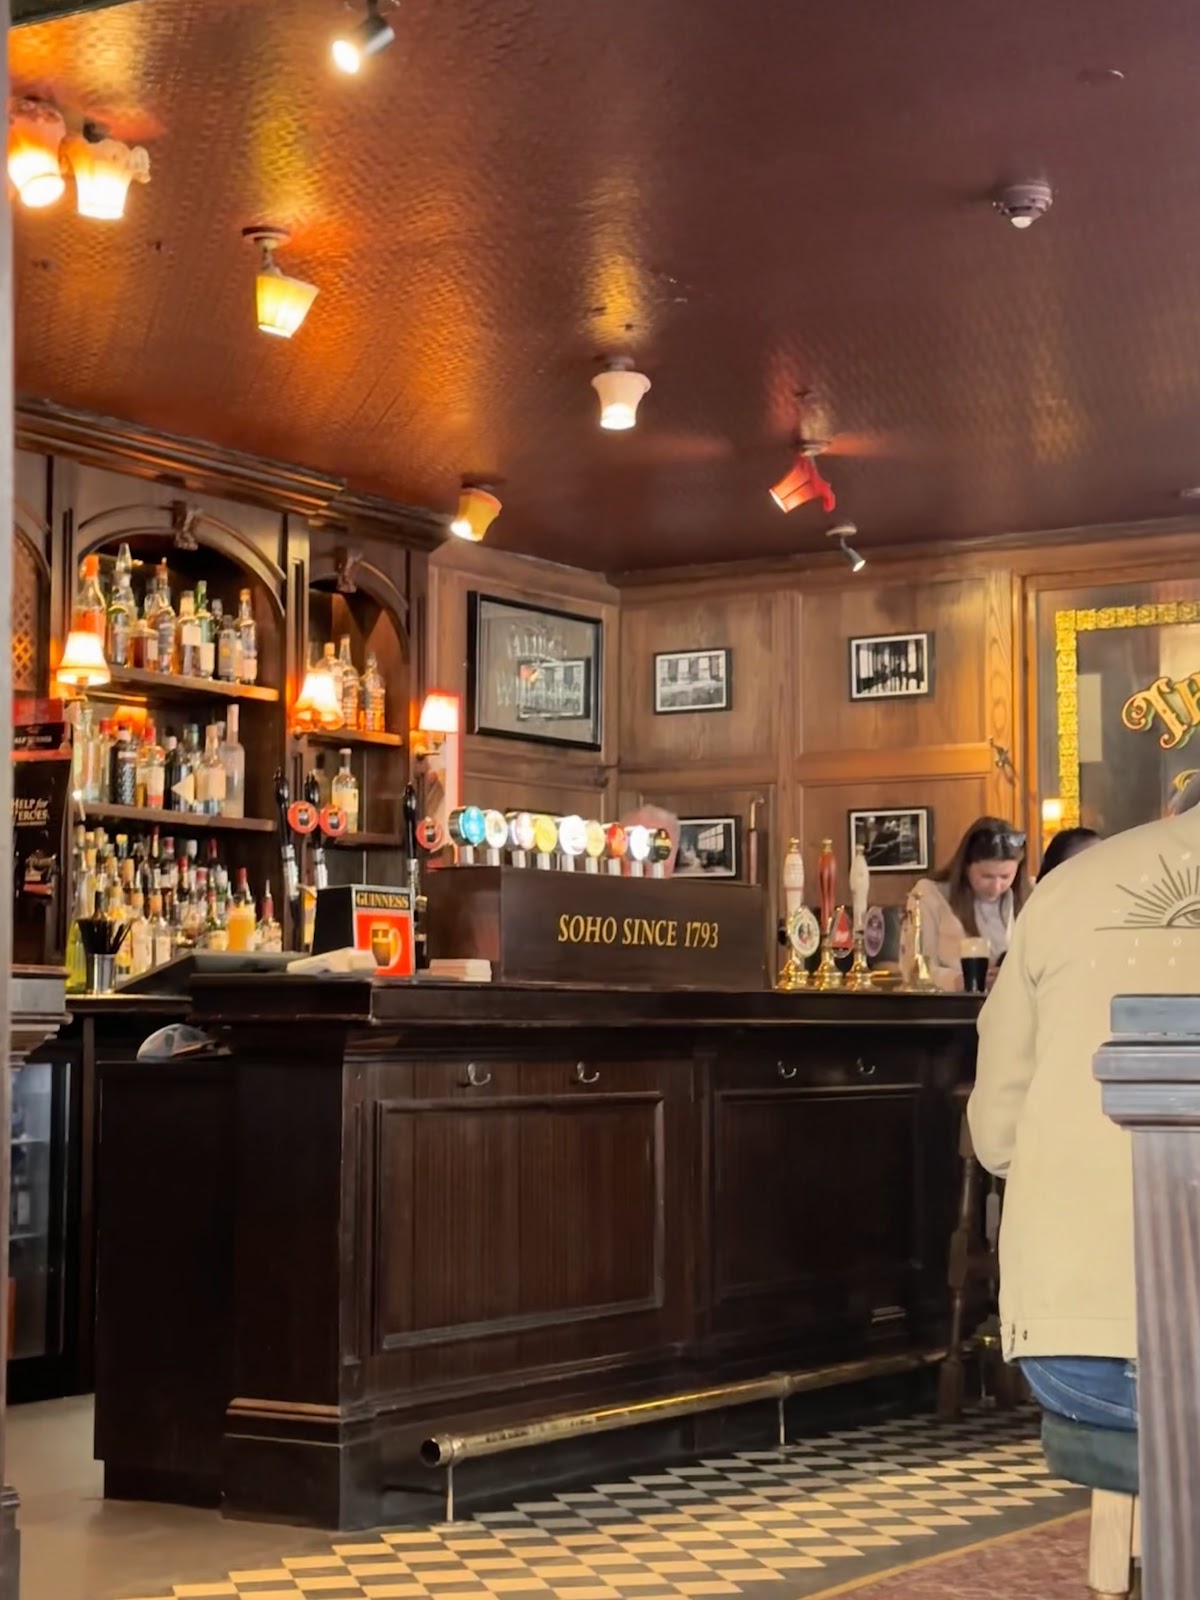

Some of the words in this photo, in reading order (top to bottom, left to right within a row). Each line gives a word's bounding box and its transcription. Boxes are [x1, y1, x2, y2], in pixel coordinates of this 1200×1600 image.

[356, 891, 409, 909] GUINNESS
[557, 913, 618, 944] SOHO
[621, 917, 678, 947] SINCE
[684, 921, 719, 949] 1793
